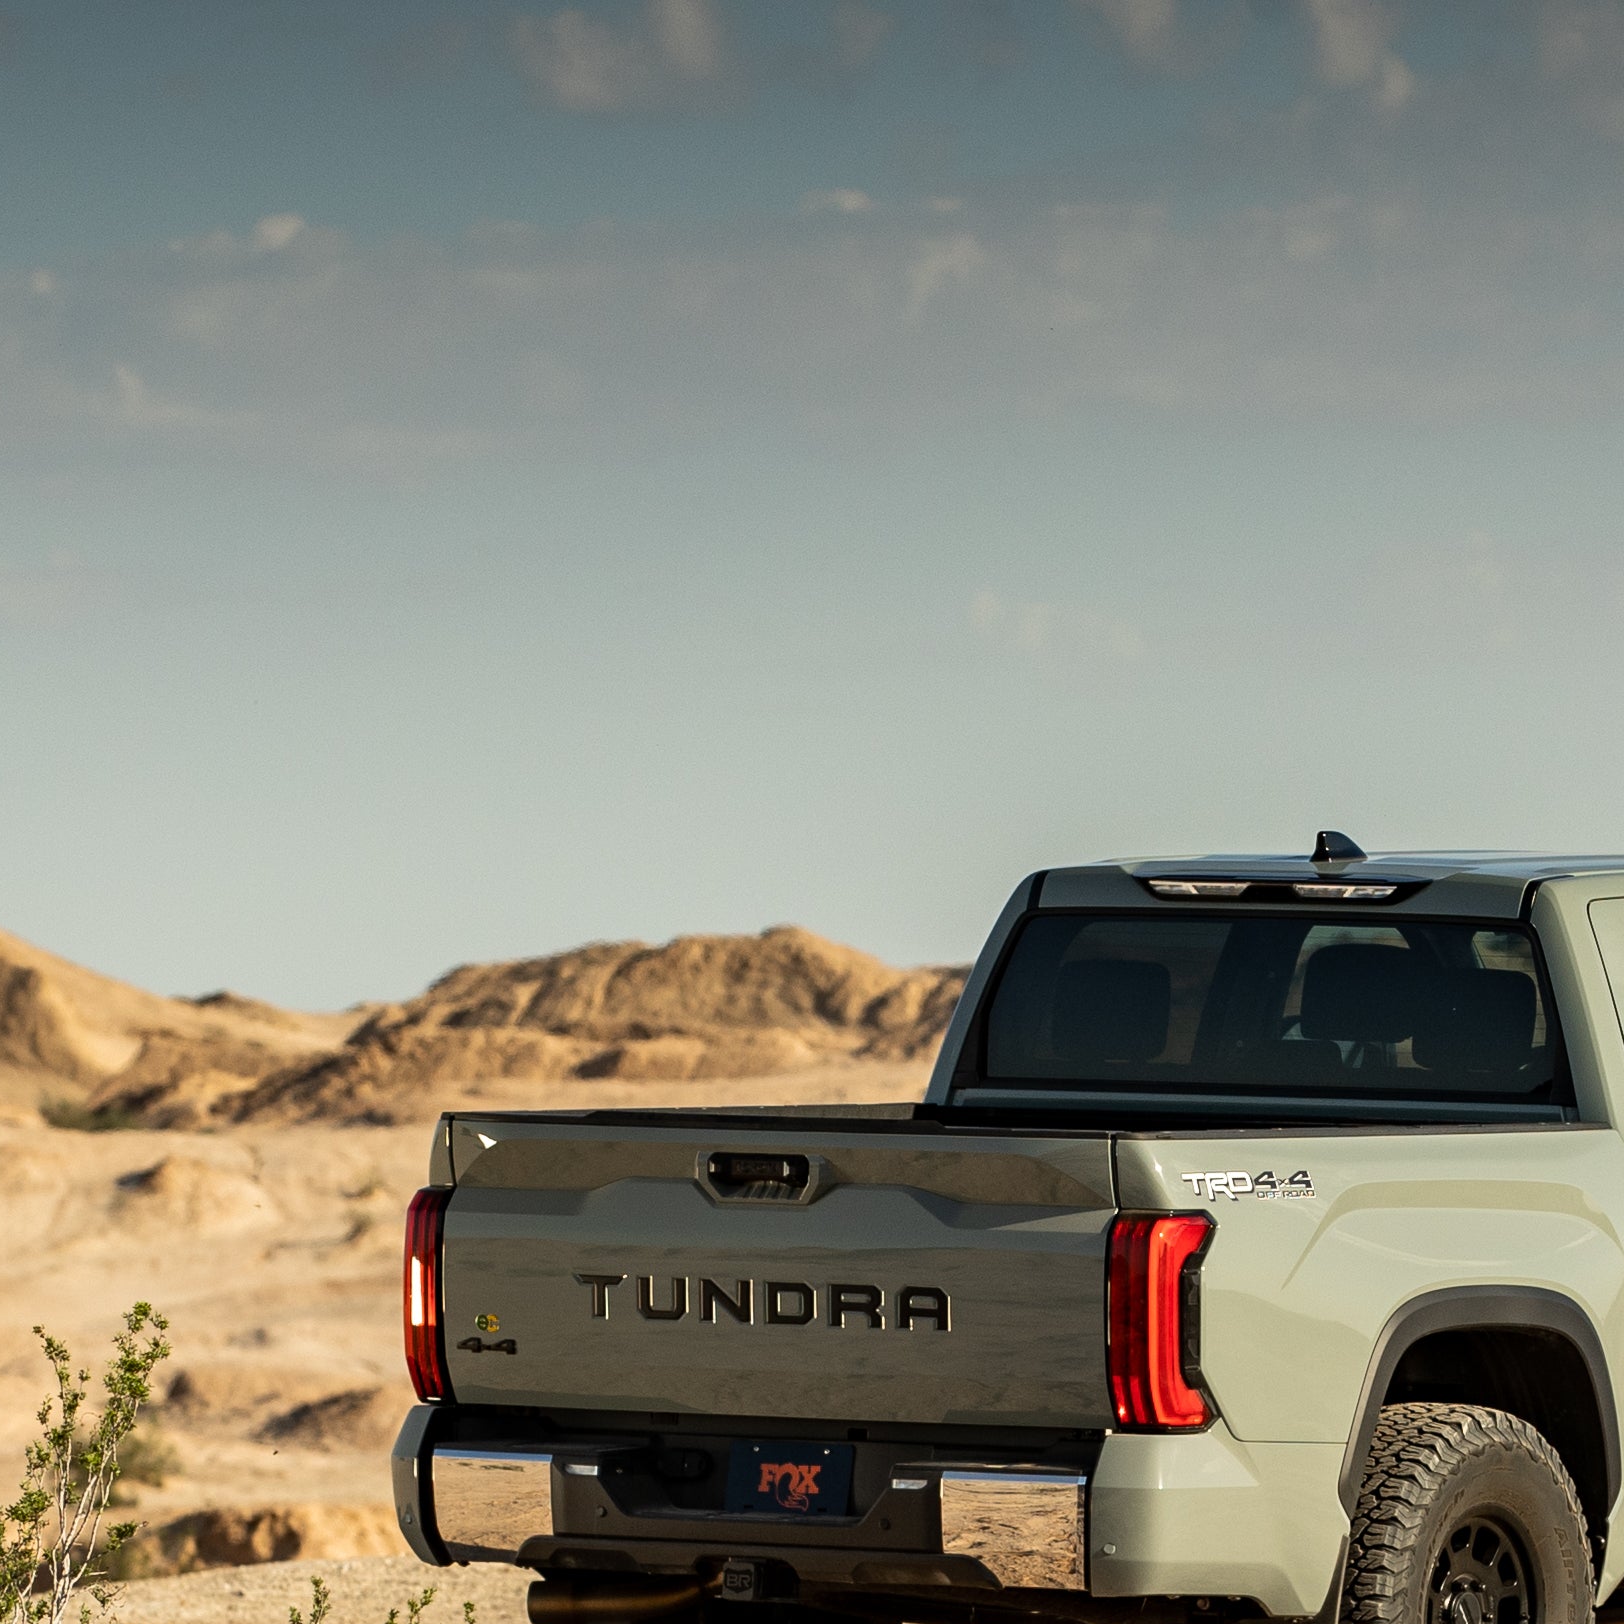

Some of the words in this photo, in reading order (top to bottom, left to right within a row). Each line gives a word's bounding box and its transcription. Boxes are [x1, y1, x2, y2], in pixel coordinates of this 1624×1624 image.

[1181, 1171, 1254, 1201] TRD
[575, 1274, 952, 1332] TUNDRA
[757, 1462, 822, 1503] FOX
[726, 1573, 752, 1588] BR
